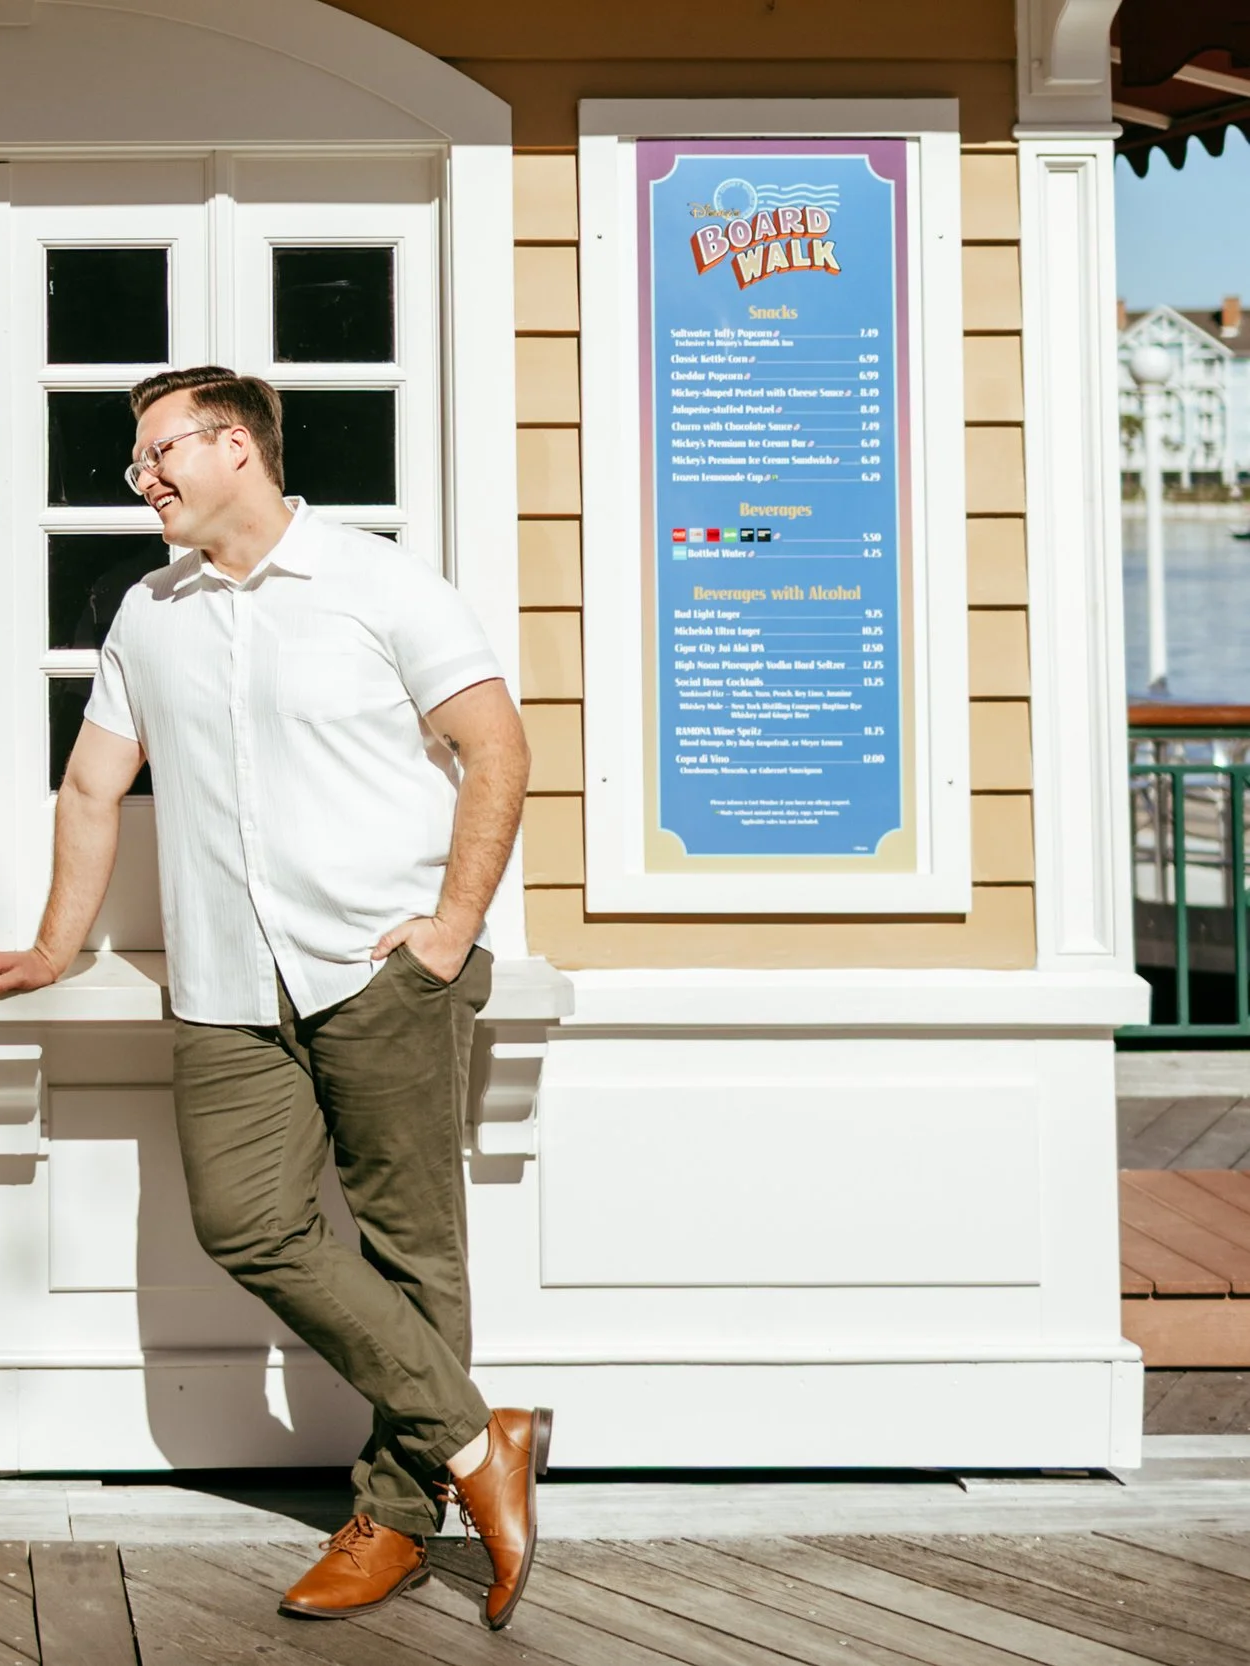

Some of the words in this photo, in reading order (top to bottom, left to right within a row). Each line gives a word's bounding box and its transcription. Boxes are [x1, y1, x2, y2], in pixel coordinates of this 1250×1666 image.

[690, 206, 831, 275] BOARD
[731, 239, 841, 290] WALK
[749, 305, 798, 319] Snacks
[671, 329, 711, 337] Saltwater
[714, 329, 735, 339] Taffy
[738, 329, 772, 339] Popcorn
[860, 328, 878, 337] 7.49
[671, 354, 698, 363] Classic
[701, 354, 725, 363] Kettle
[728, 355, 748, 363] Corn
[859, 354, 879, 363] 6.99
[671, 371, 705, 380] Cheddar
[709, 371, 743, 382] Popcorn
[859, 371, 879, 380] 6.99
[672, 388, 733, 399] Mickey-shaped
[735, 388, 764, 397] Pretzel
[767, 388, 786, 397] with
[789, 388, 817, 397] Cheese
[820, 388, 843, 397] Sauce
[861, 388, 879, 397] 8.49
[746, 405, 774, 414] Pretzel
[861, 405, 879, 414] 8.49
[672, 422, 700, 431] Churro
[703, 422, 722, 431] with
[725, 422, 766, 431] Chocolate
[768, 422, 792, 431] Sauce
[861, 422, 879, 430] 7.49
[708, 439, 746, 448] Premium
[749, 440, 760, 448] Ice
[763, 439, 789, 447] Cream
[792, 439, 807, 448] Bar
[861, 439, 880, 448] 6.49
[708, 456, 746, 464] Premium
[749, 456, 760, 464] Ice
[763, 456, 789, 464] Cream
[792, 456, 832, 464] Sandwich
[861, 455, 880, 464] 6.49
[673, 473, 699, 481] Frozen
[702, 472, 745, 481] Lemonade
[748, 473, 763, 483] Cup
[862, 472, 880, 481] 6.29
[740, 502, 812, 520] Beverages
[863, 533, 881, 542] 5.50
[688, 549, 719, 558] Bottled
[722, 549, 747, 558] Water
[863, 549, 882, 558] 4.25
[694, 586, 766, 603] Beverages
[771, 585, 804, 600] with
[809, 585, 861, 600] Alcohol
[675, 609, 691, 618] Bud
[694, 609, 715, 620] Light
[717, 610, 740, 620] Lager
[865, 609, 883, 618] 9.75
